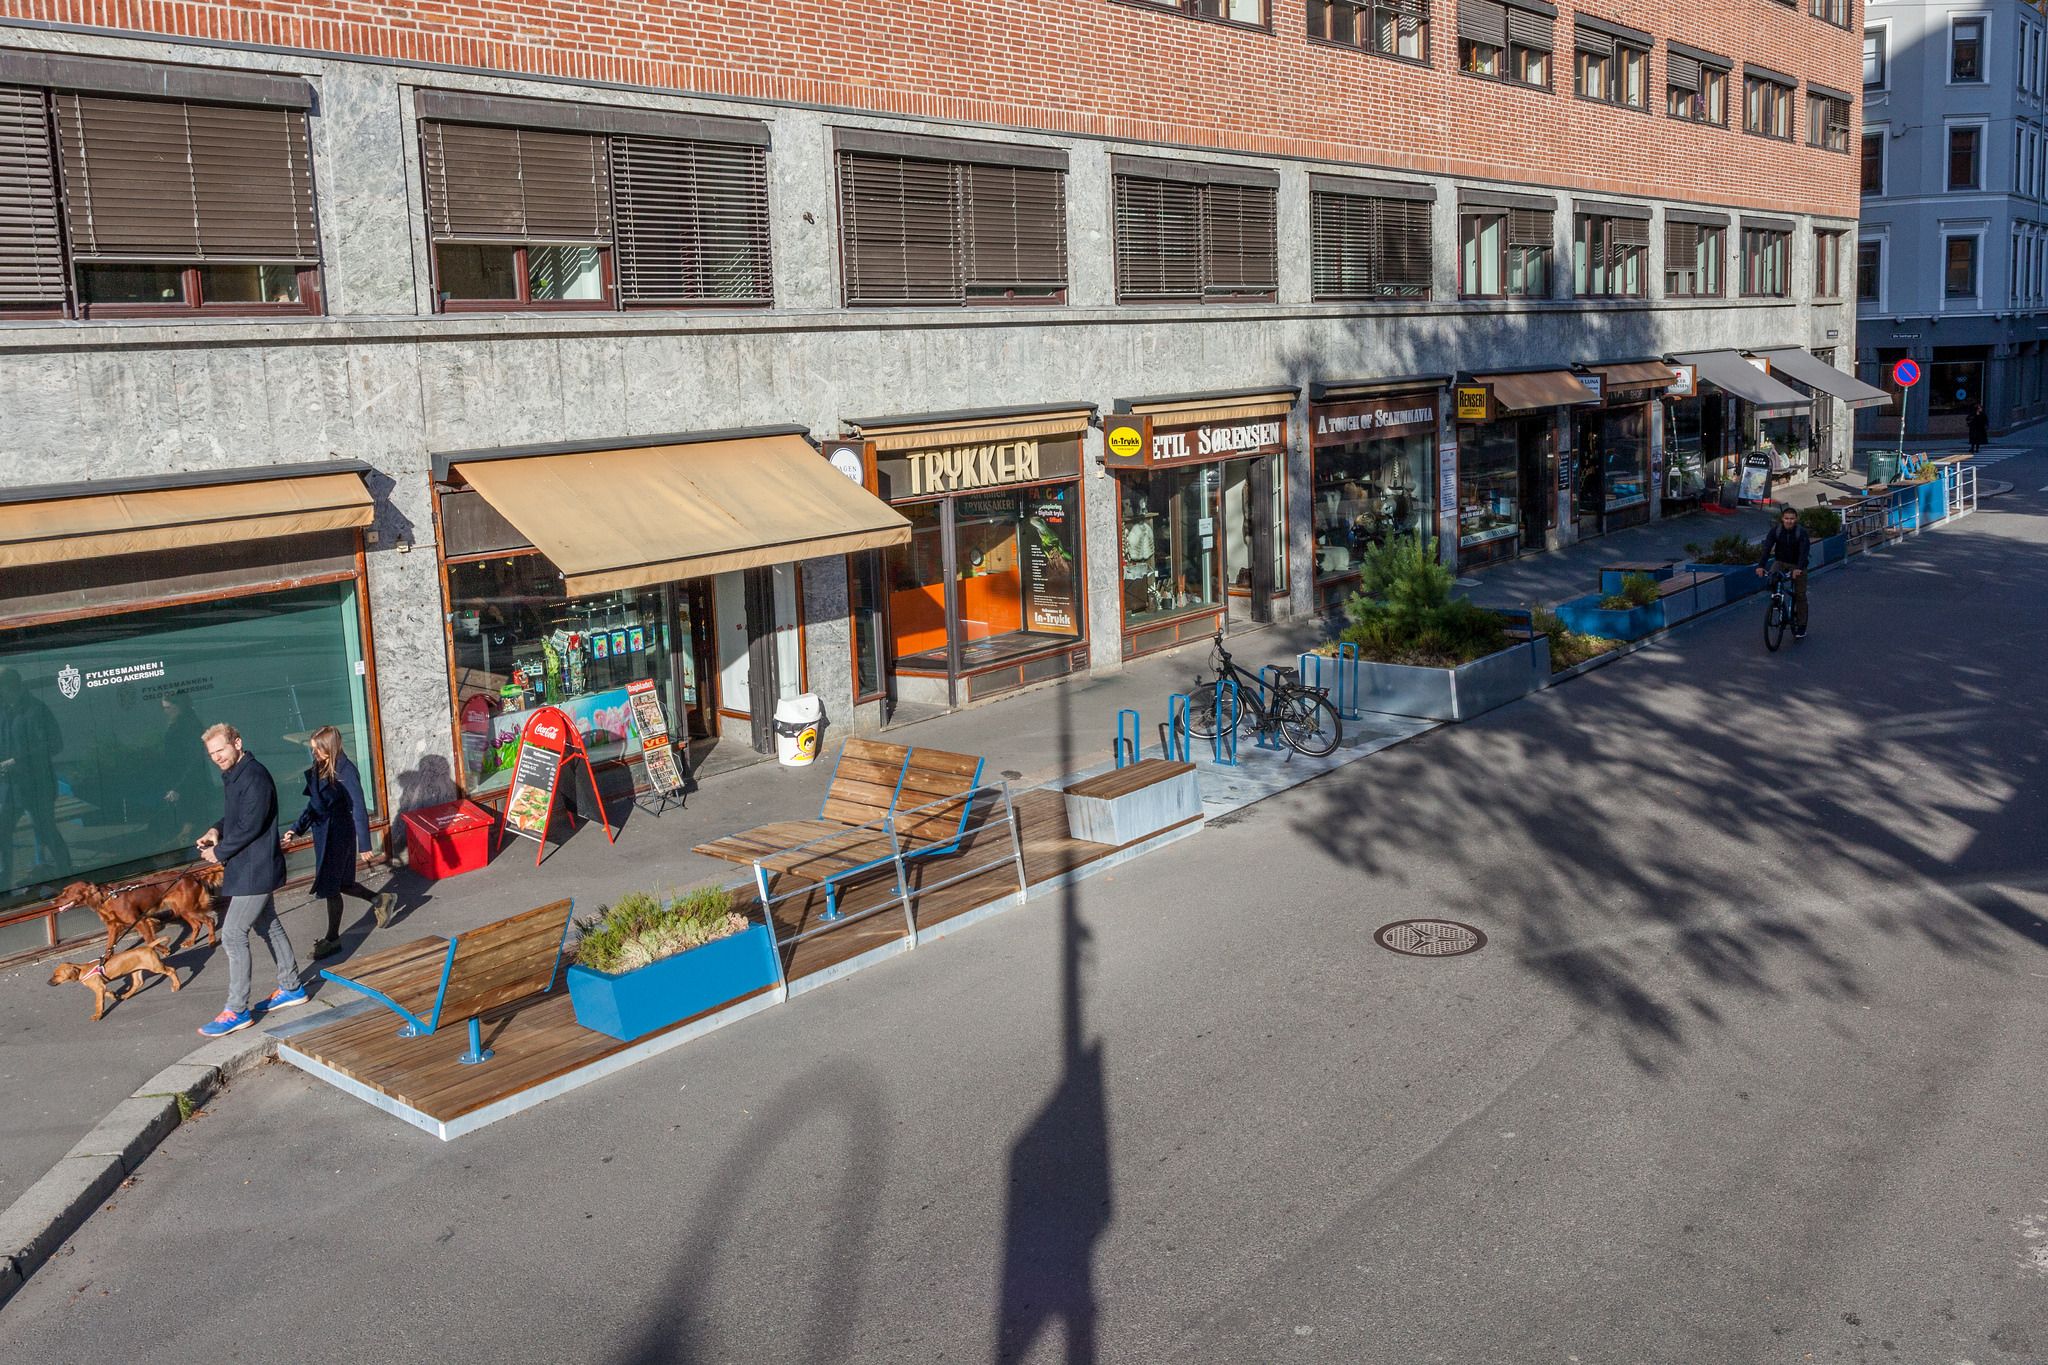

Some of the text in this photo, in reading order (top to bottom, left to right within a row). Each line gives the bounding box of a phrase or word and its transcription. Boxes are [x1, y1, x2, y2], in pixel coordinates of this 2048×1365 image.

[1459, 390, 1485, 408] RENSERI
[1317, 407, 1433, 434] A TOUCH OF SCANDINAVIA
[1111, 437, 1140, 446] In-Trykk
[1153, 421, 1280, 460] ETIL SØRENSEN
[906, 438, 1040, 496] TRYKKERI
[1034, 612, 1071, 625] In-Trykk
[86, 662, 158, 680] FYLKESMANNEN
[86, 669, 165, 688] OSLO OG AKERSHUS
[627, 681, 653, 693] Dagbladet
[534, 723, 559, 740] Coca-Cola
[644, 735, 667, 749] VG
